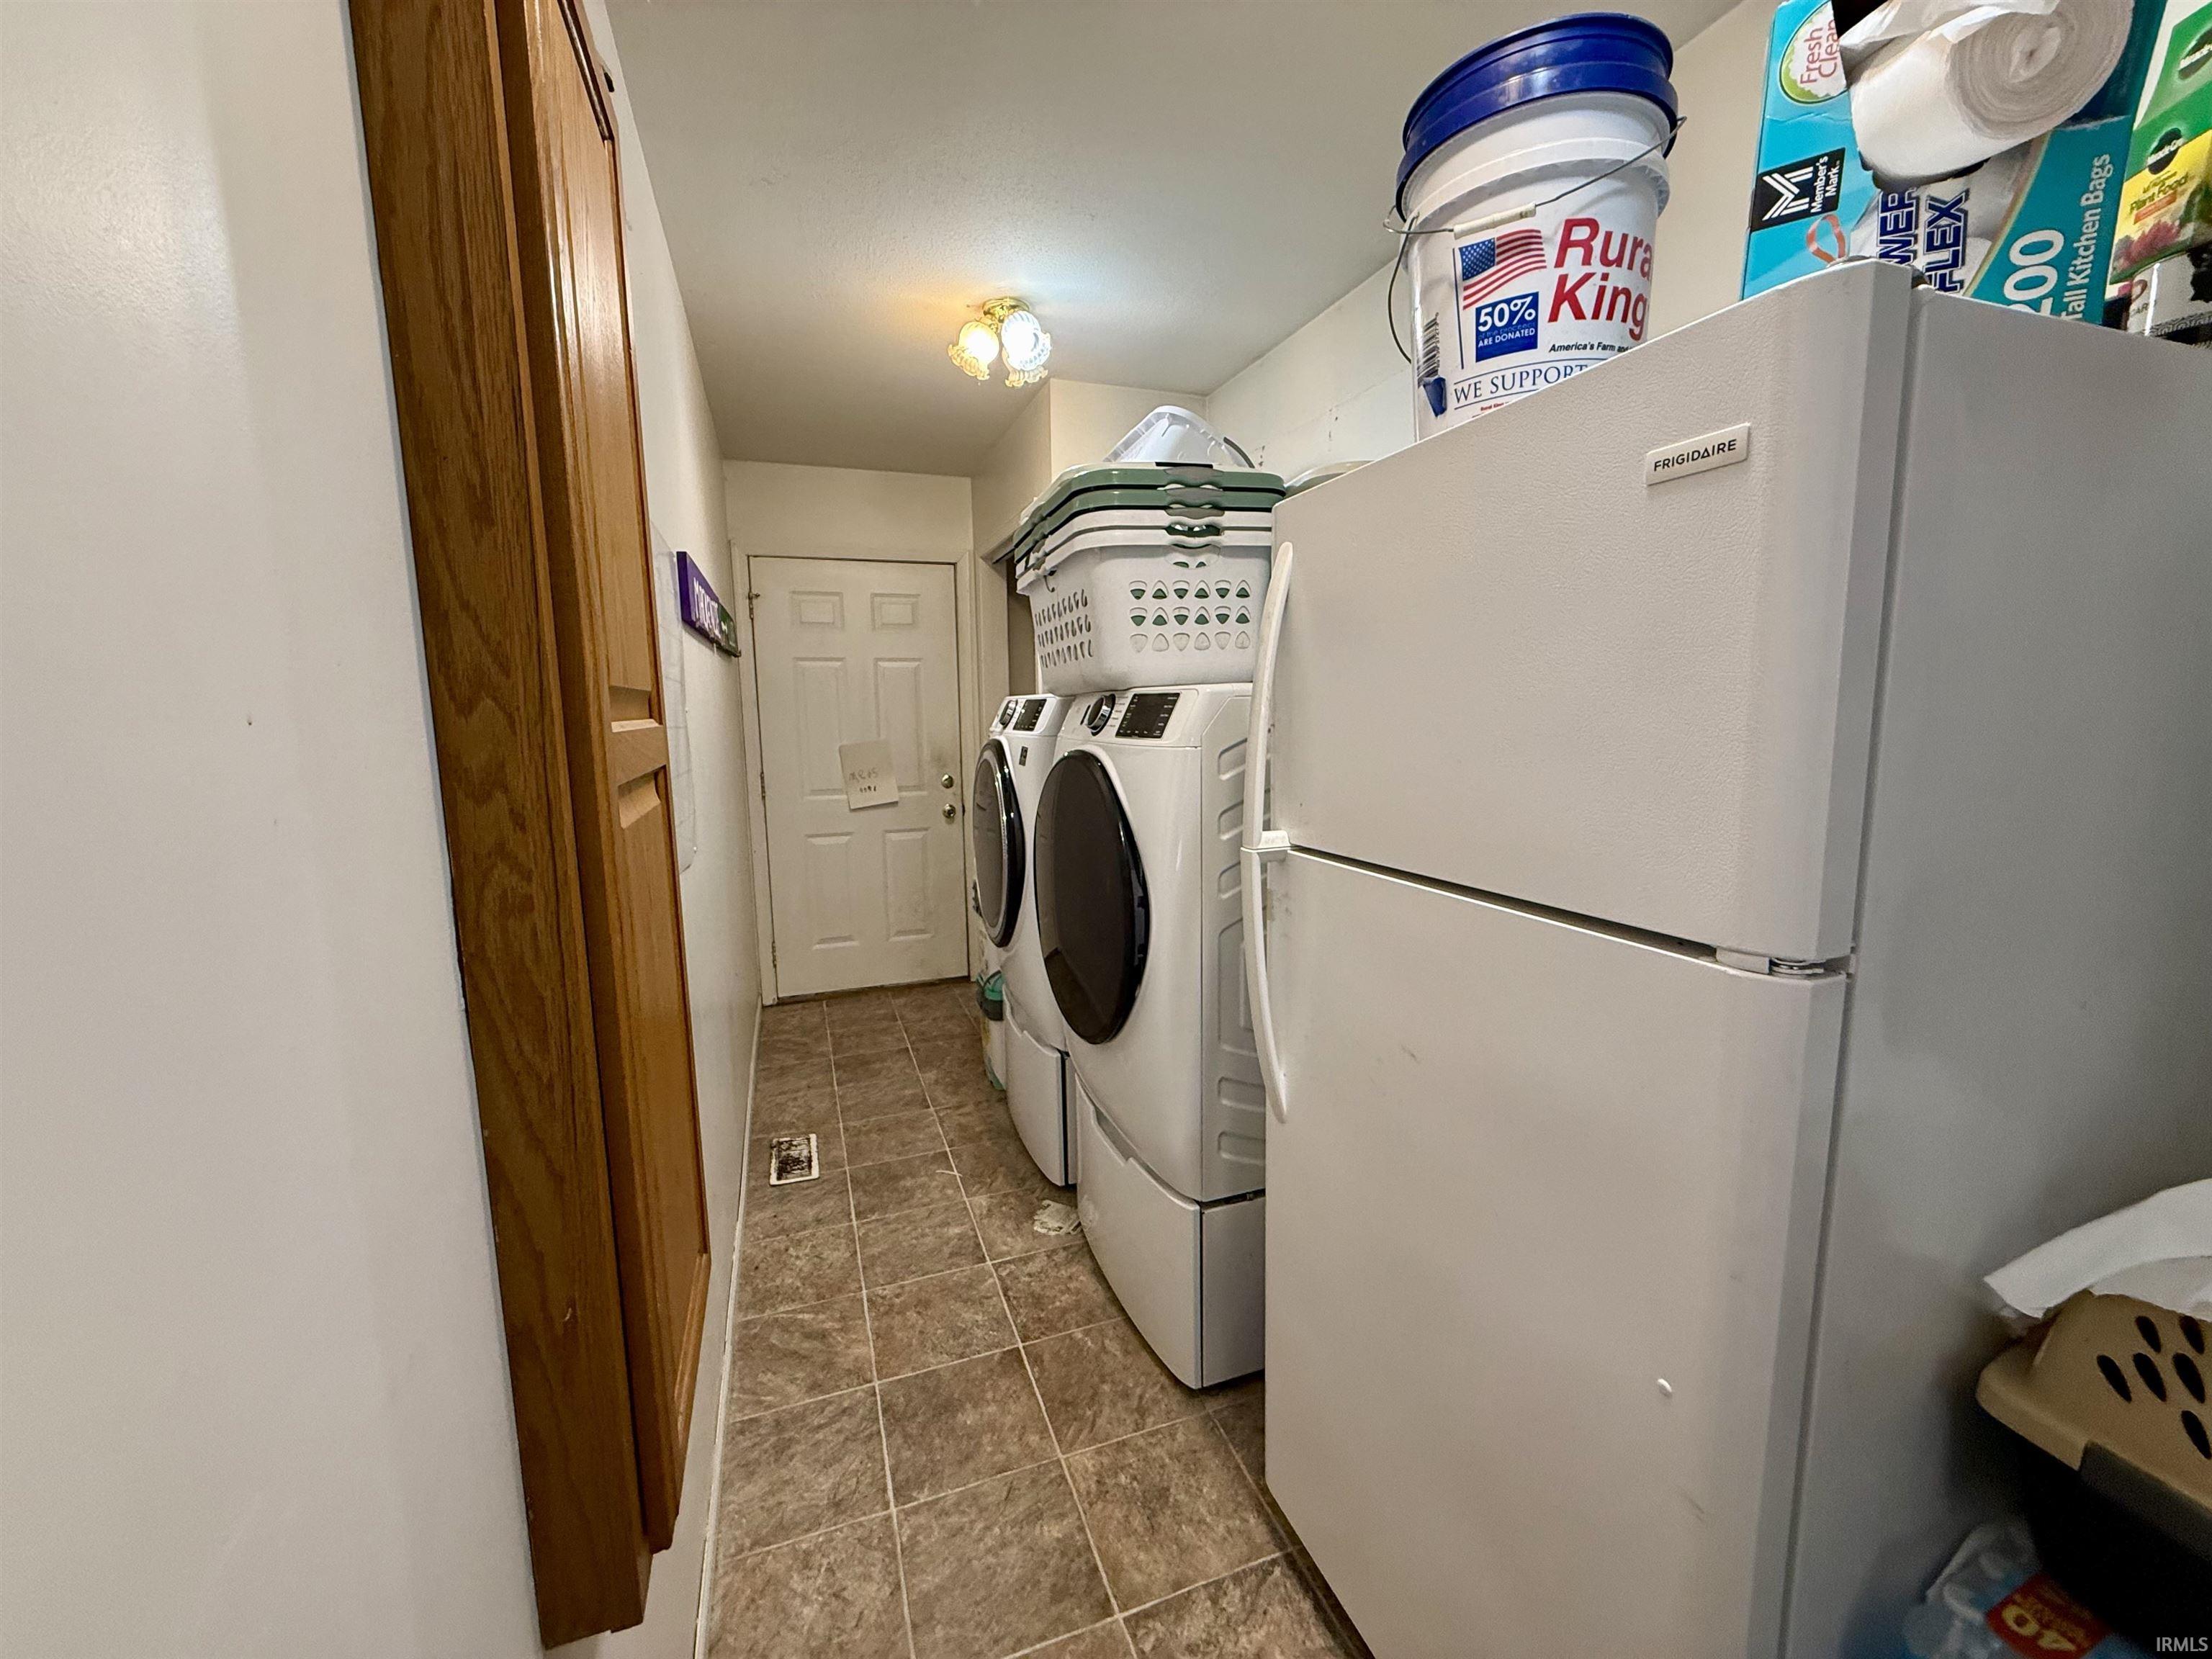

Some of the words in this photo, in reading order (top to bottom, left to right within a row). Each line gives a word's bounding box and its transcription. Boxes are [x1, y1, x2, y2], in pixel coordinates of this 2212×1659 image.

[1800, 27, 1823, 84] Fresh
[1809, 156, 1828, 213] Member's
[1825, 165, 1840, 197] Mark
[2080, 153, 2114, 207] Bags
[2066, 208, 2102, 286] Kitchen
[1478, 296, 1536, 332] 50%
[1547, 272, 1647, 342] King
[2060, 288, 2088, 320] Tall
[1478, 336, 1493, 348] ARE
[1495, 328, 1535, 343] DONATED
[1548, 341, 1594, 353] America's
[1596, 341, 1616, 351] Farm
[1454, 380, 1483, 404] WE
[1654, 439, 1737, 472] FRIGIDAIRE
